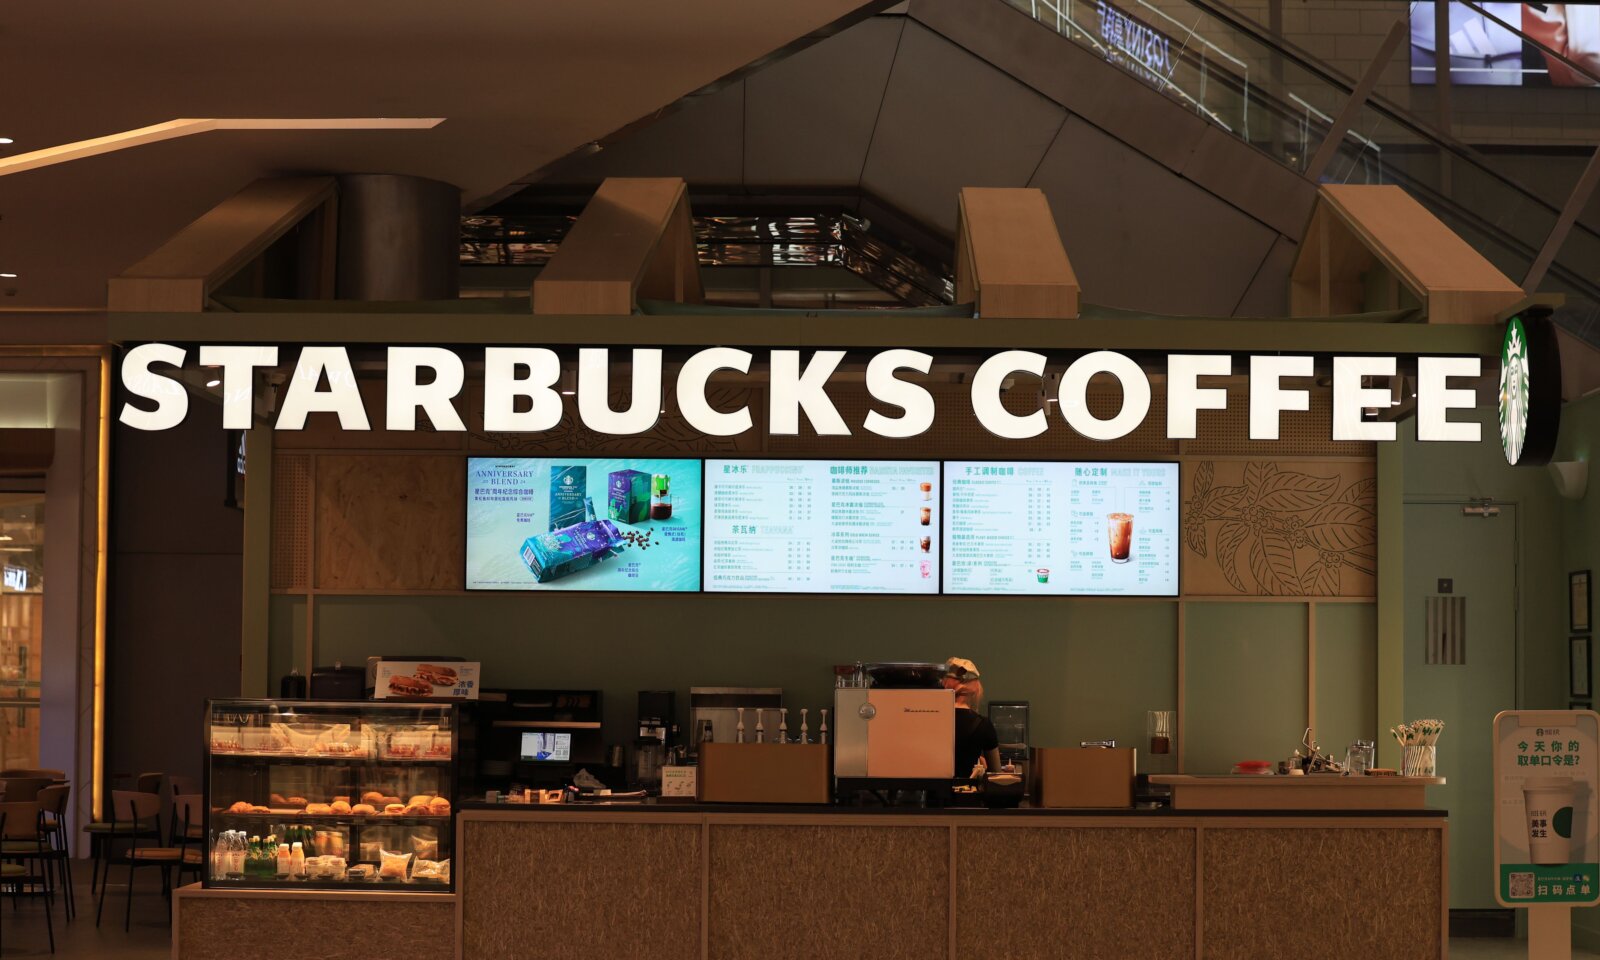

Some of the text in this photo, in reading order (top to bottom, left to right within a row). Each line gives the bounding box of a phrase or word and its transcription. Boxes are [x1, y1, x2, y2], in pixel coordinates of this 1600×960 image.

[119, 343, 1482, 441] STARBUCKS COFFEE
[475, 470, 534, 478] ANNIVERSARY
[723, 465, 748, 475] 星冰乐
[829, 465, 869, 476] 咖啡师推荐
[965, 466, 1014, 476] 手工调制咖啡
[1075, 467, 1108, 477] 随心定制
[1517, 741, 1580, 752] 今天你的
[1531, 819, 1548, 828] 美事
[1531, 829, 1548, 838] 发生
[1537, 884, 1592, 896] 扫码点单
